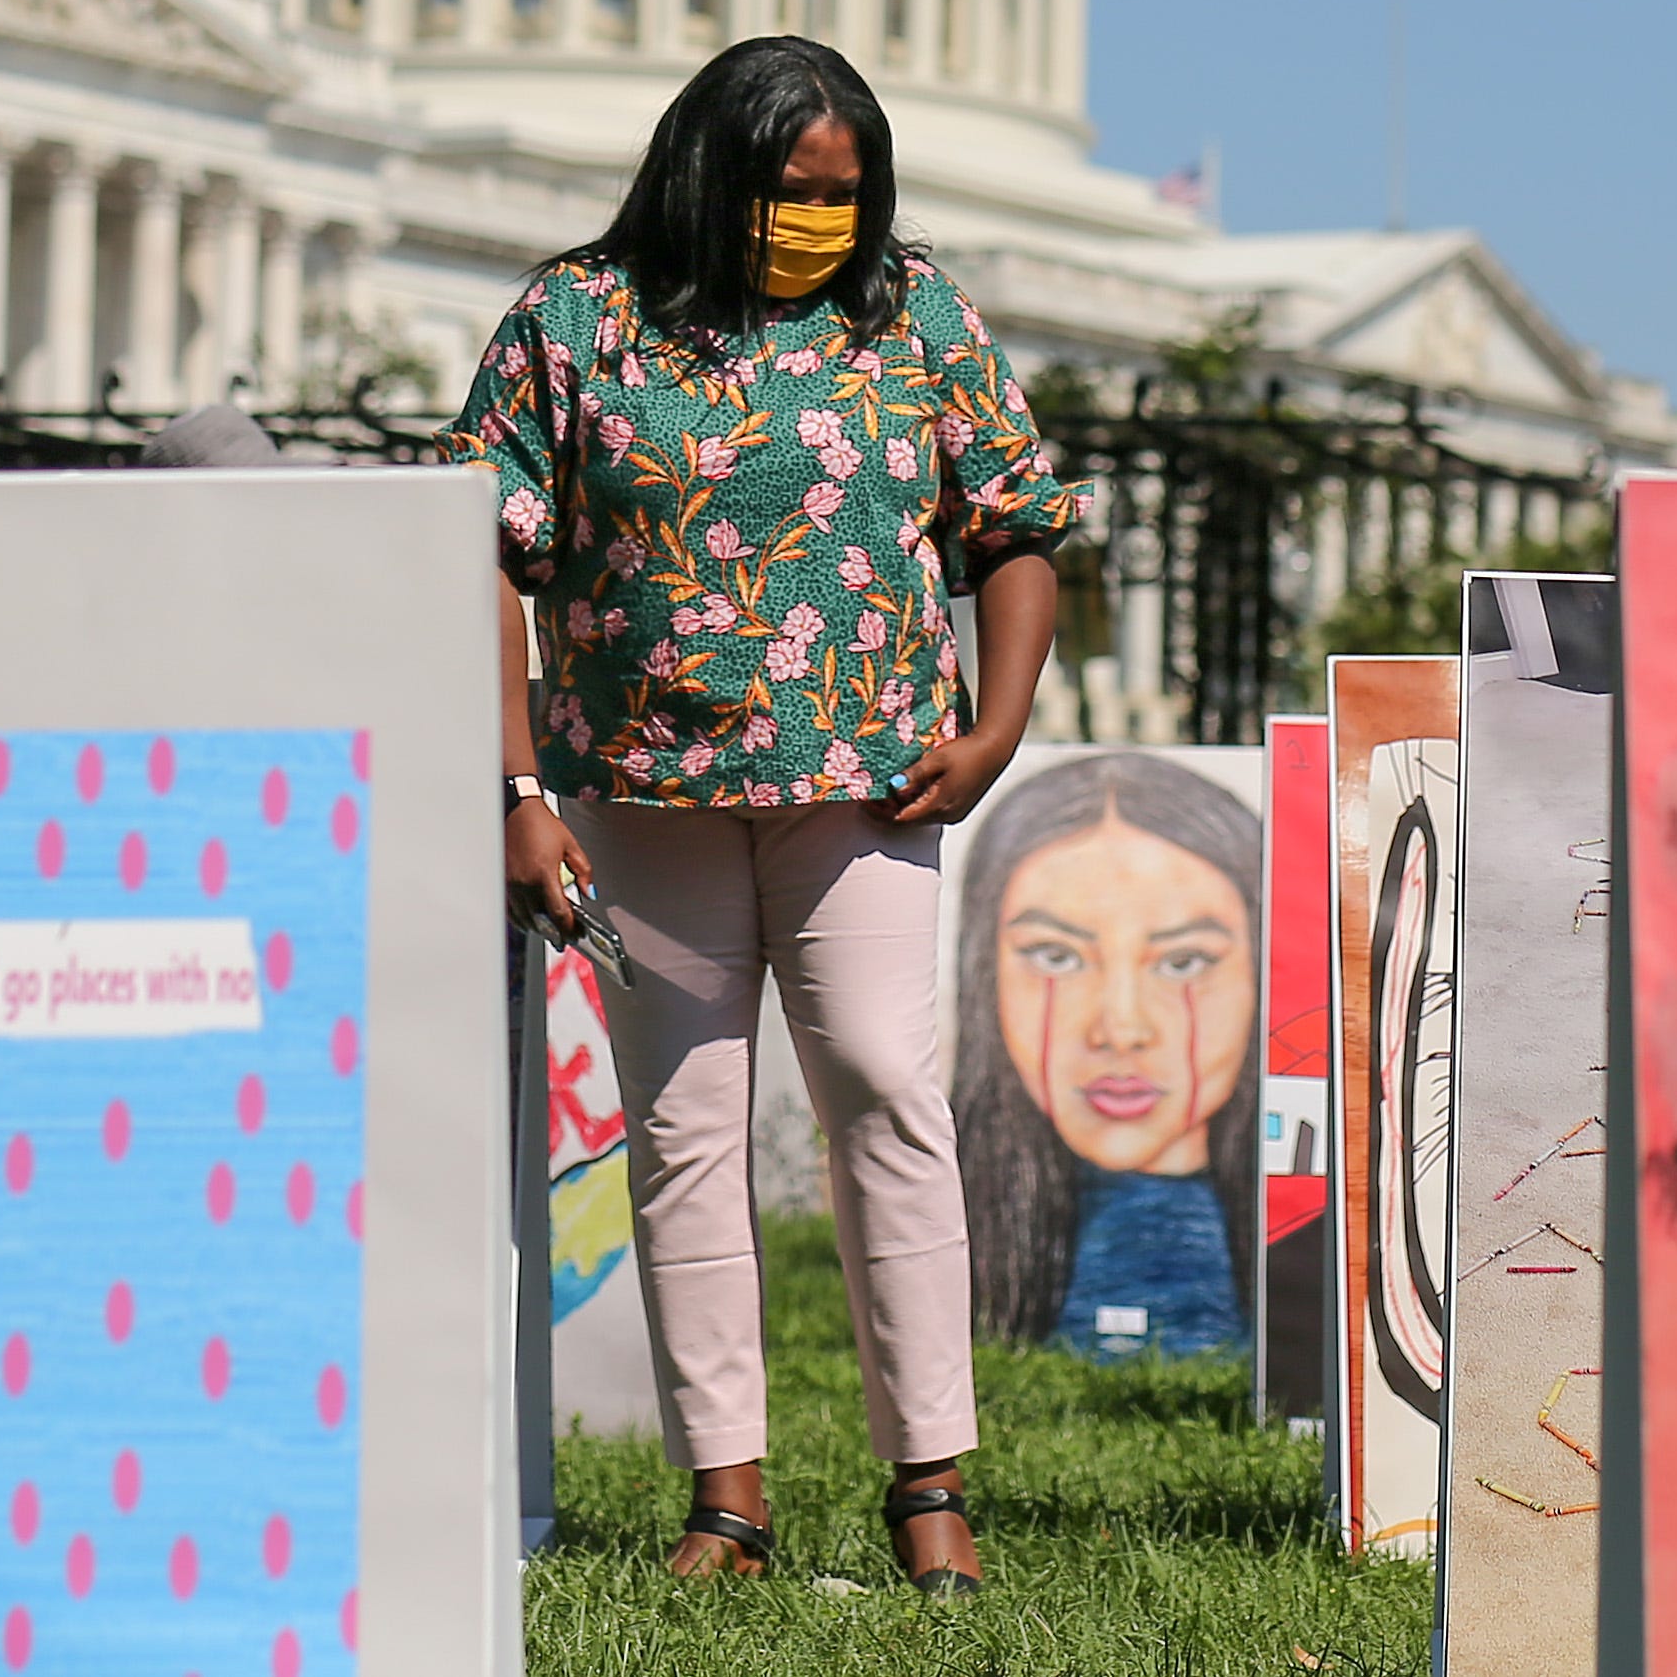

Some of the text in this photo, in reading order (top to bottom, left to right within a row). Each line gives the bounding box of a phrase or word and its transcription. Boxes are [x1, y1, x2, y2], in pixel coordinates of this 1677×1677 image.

[2, 969, 42, 1023] go
[48, 953, 138, 1021] places
[145, 953, 210, 1004] with
[217, 967, 254, 1005] no
